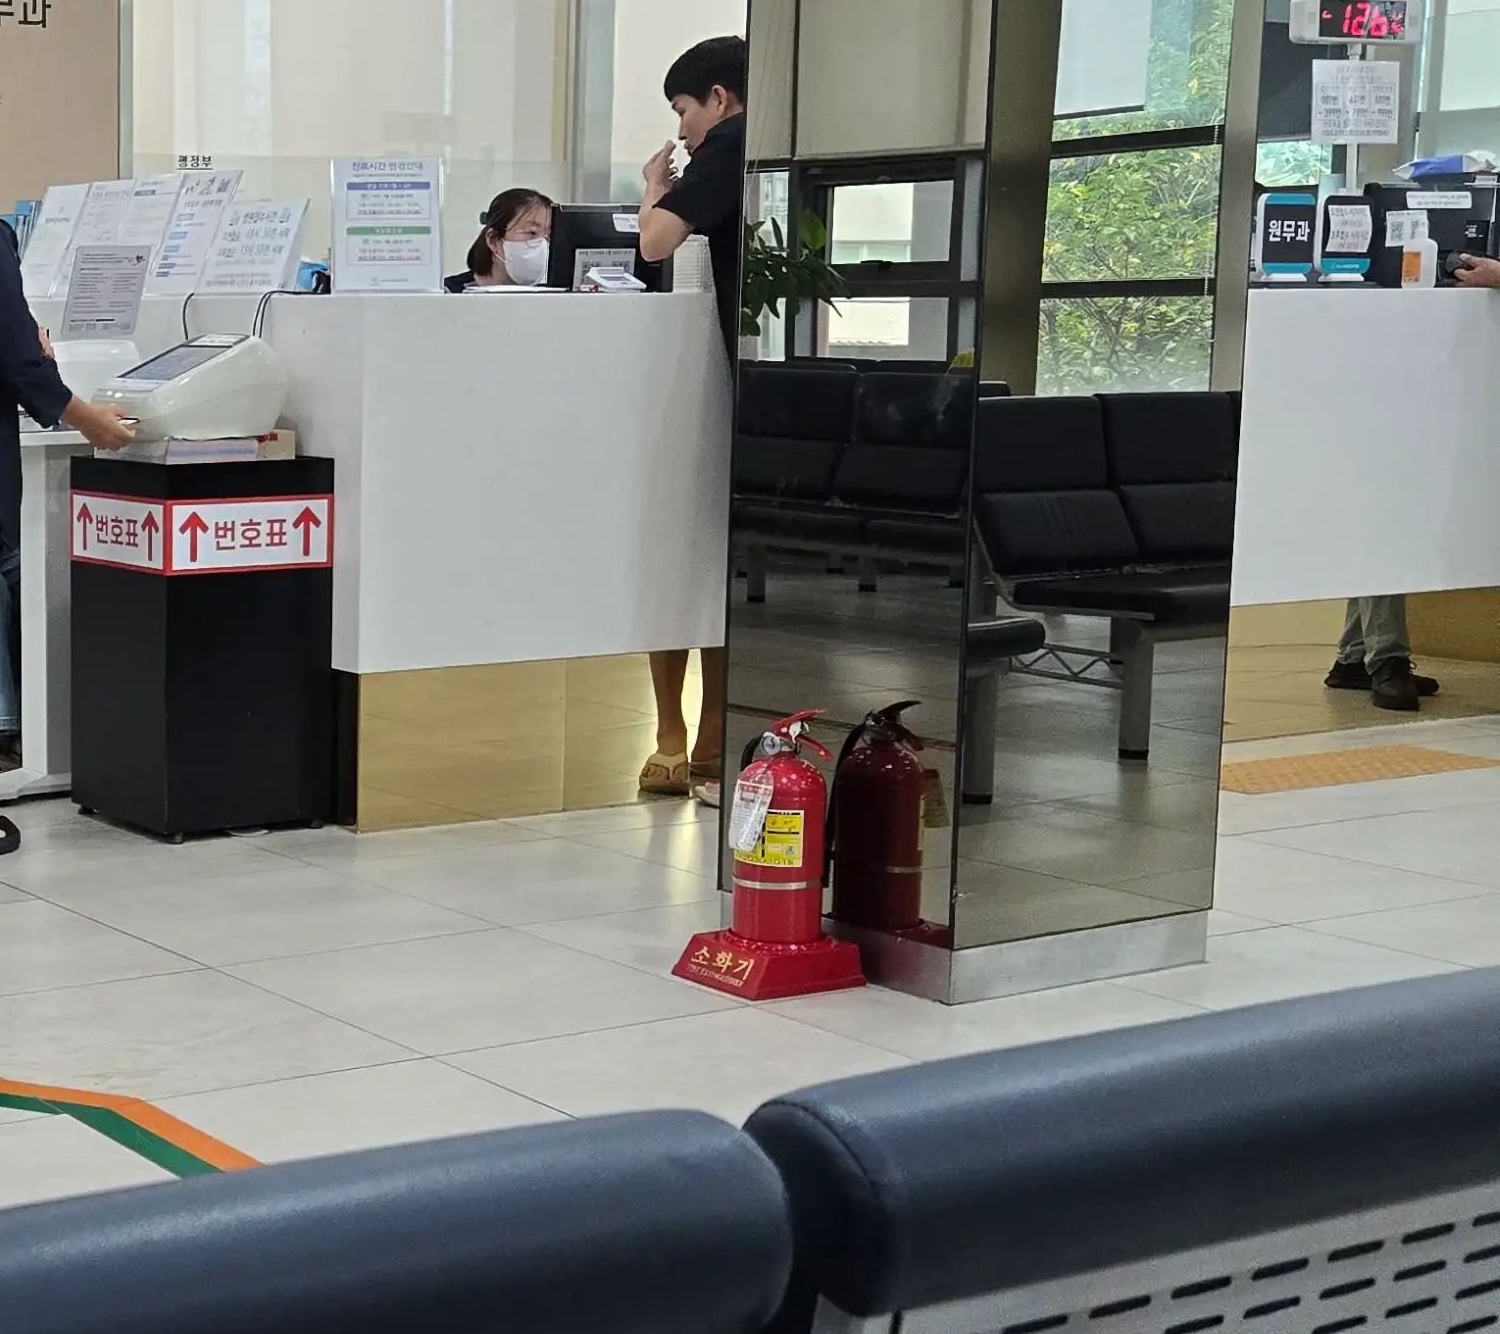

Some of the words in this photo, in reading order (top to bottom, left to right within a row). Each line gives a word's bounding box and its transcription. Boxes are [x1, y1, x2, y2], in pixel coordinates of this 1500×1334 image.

[178, 155, 212, 168] 행정부
[1268, 220, 1310, 243] 원무과
[95, 514, 139, 548] 번호표
[214, 518, 287, 551] 번호표
[691, 946, 755, 981] 소화기
